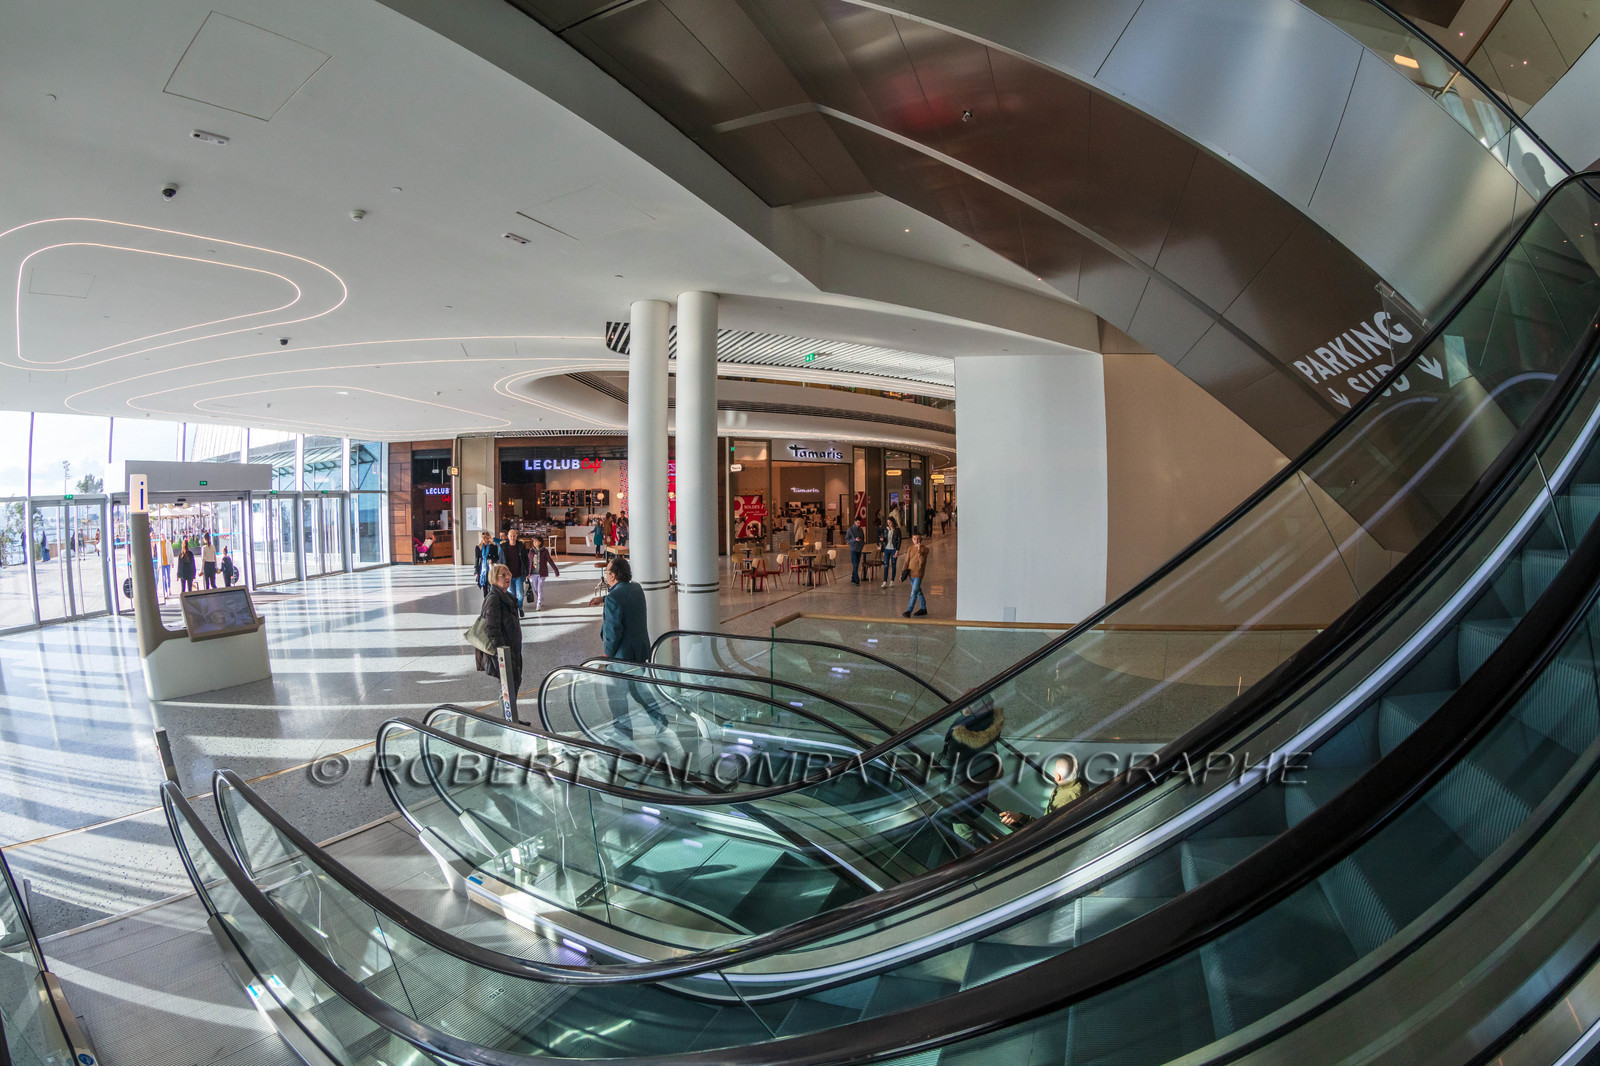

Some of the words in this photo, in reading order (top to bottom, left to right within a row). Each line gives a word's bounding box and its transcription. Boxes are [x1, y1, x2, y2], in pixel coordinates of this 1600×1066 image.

[1293, 311, 1413, 384] PARKING
[524, 459, 541, 470] LE
[543, 459, 580, 470] CLUB
